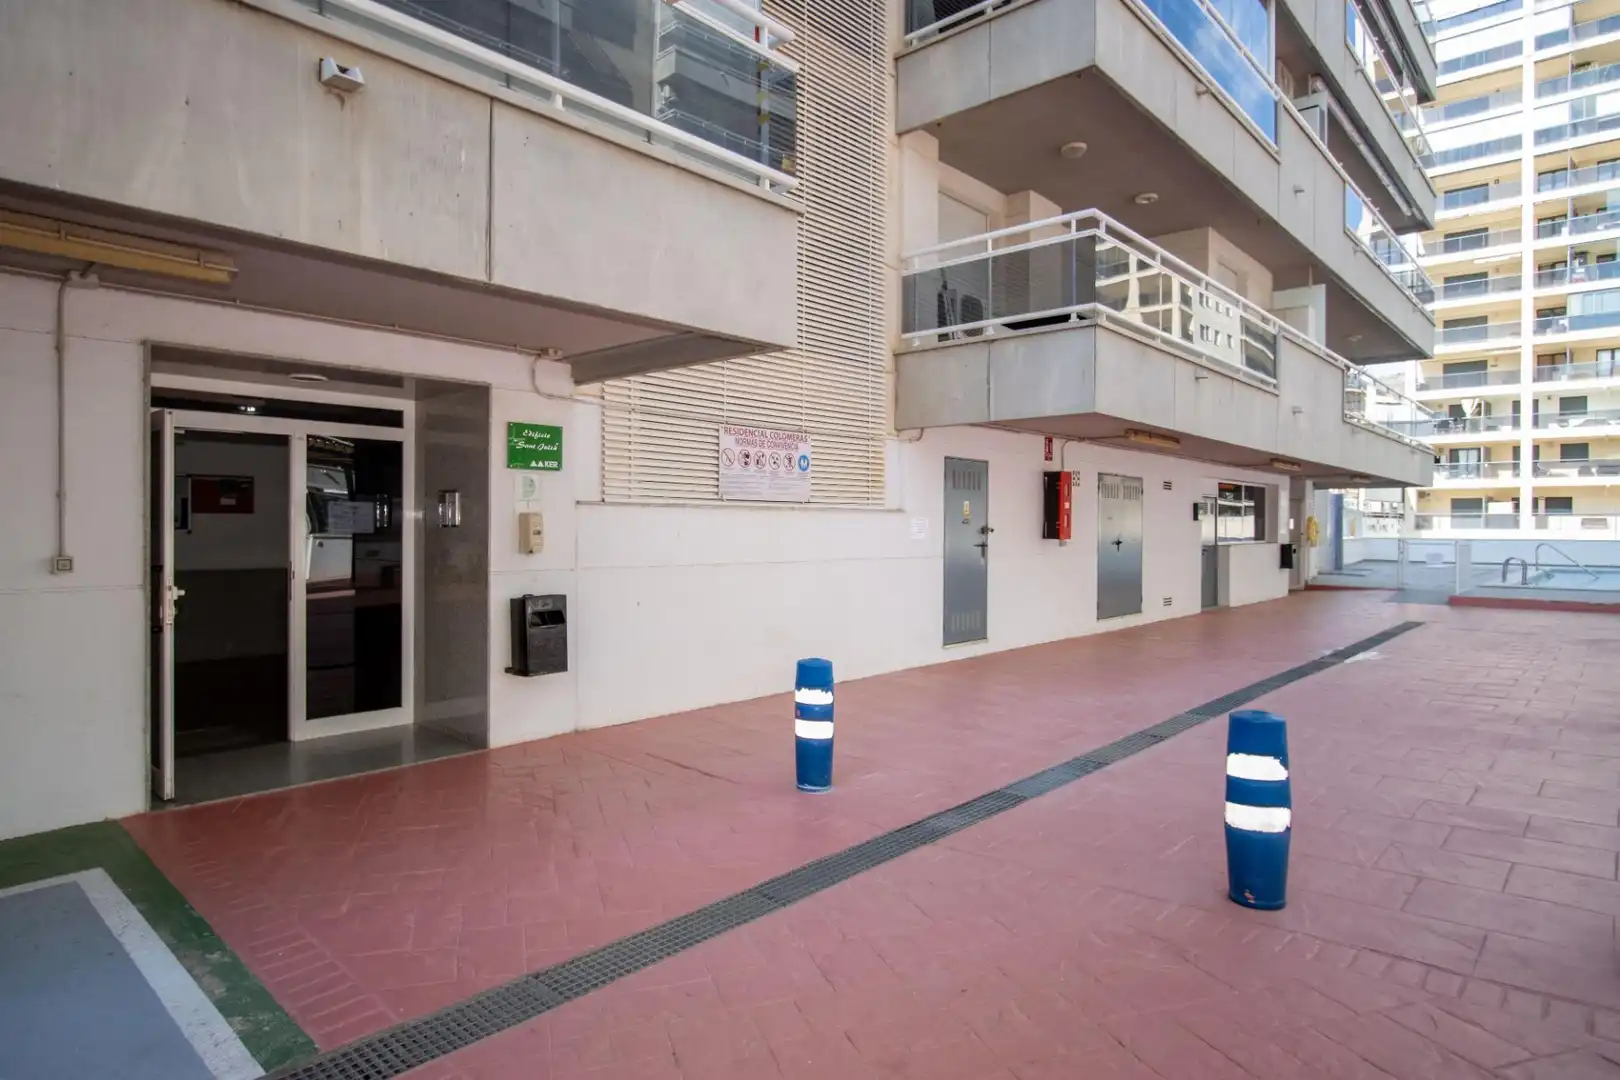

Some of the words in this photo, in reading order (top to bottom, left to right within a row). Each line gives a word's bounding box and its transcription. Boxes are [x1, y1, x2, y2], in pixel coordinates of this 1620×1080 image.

[723, 426, 768, 439] RESIDENCIAL
[770, 431, 808, 443] COLOMERAS
[735, 437, 758, 448] NORMAS
[759, 439, 766, 448] DE
